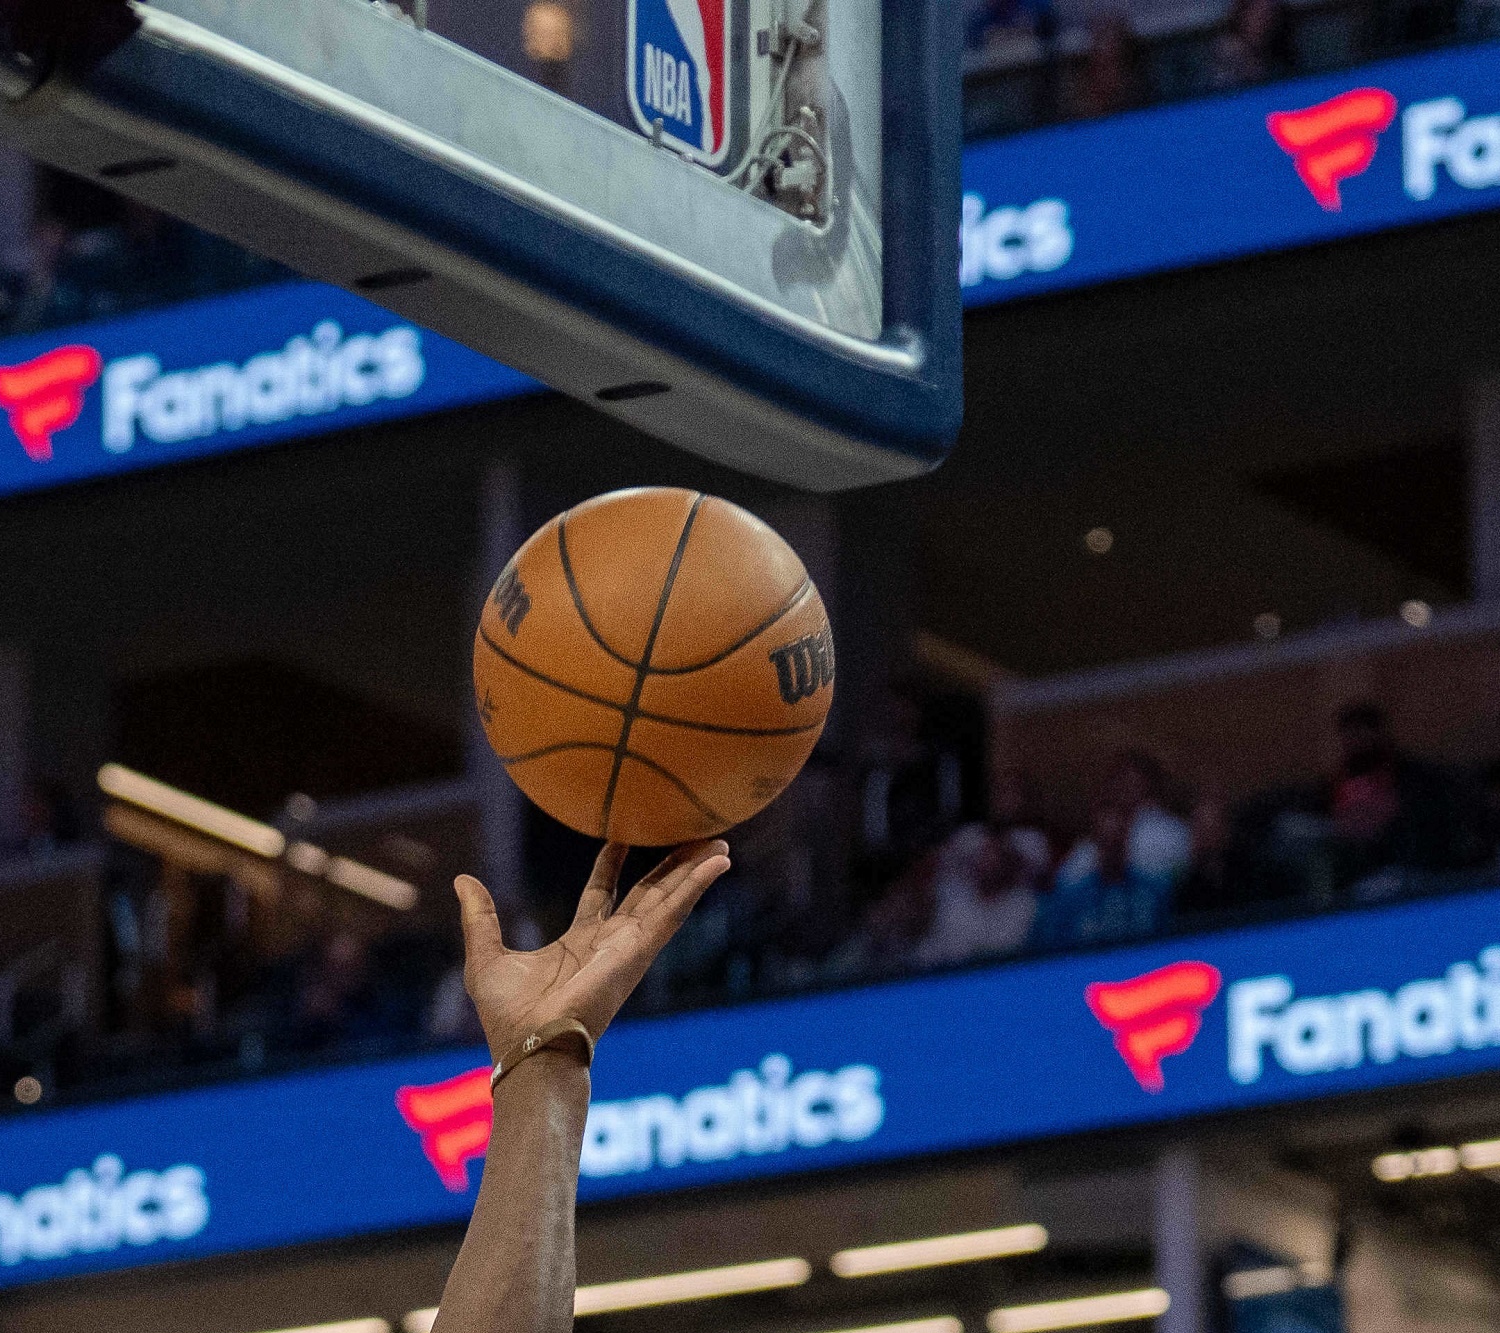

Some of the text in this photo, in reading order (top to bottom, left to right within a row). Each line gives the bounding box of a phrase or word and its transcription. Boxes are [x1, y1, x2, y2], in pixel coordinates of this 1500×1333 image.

[642, 42, 693, 127] NBA
[102, 322, 423, 453] Fanatics
[578, 1055, 884, 1177] anatics
